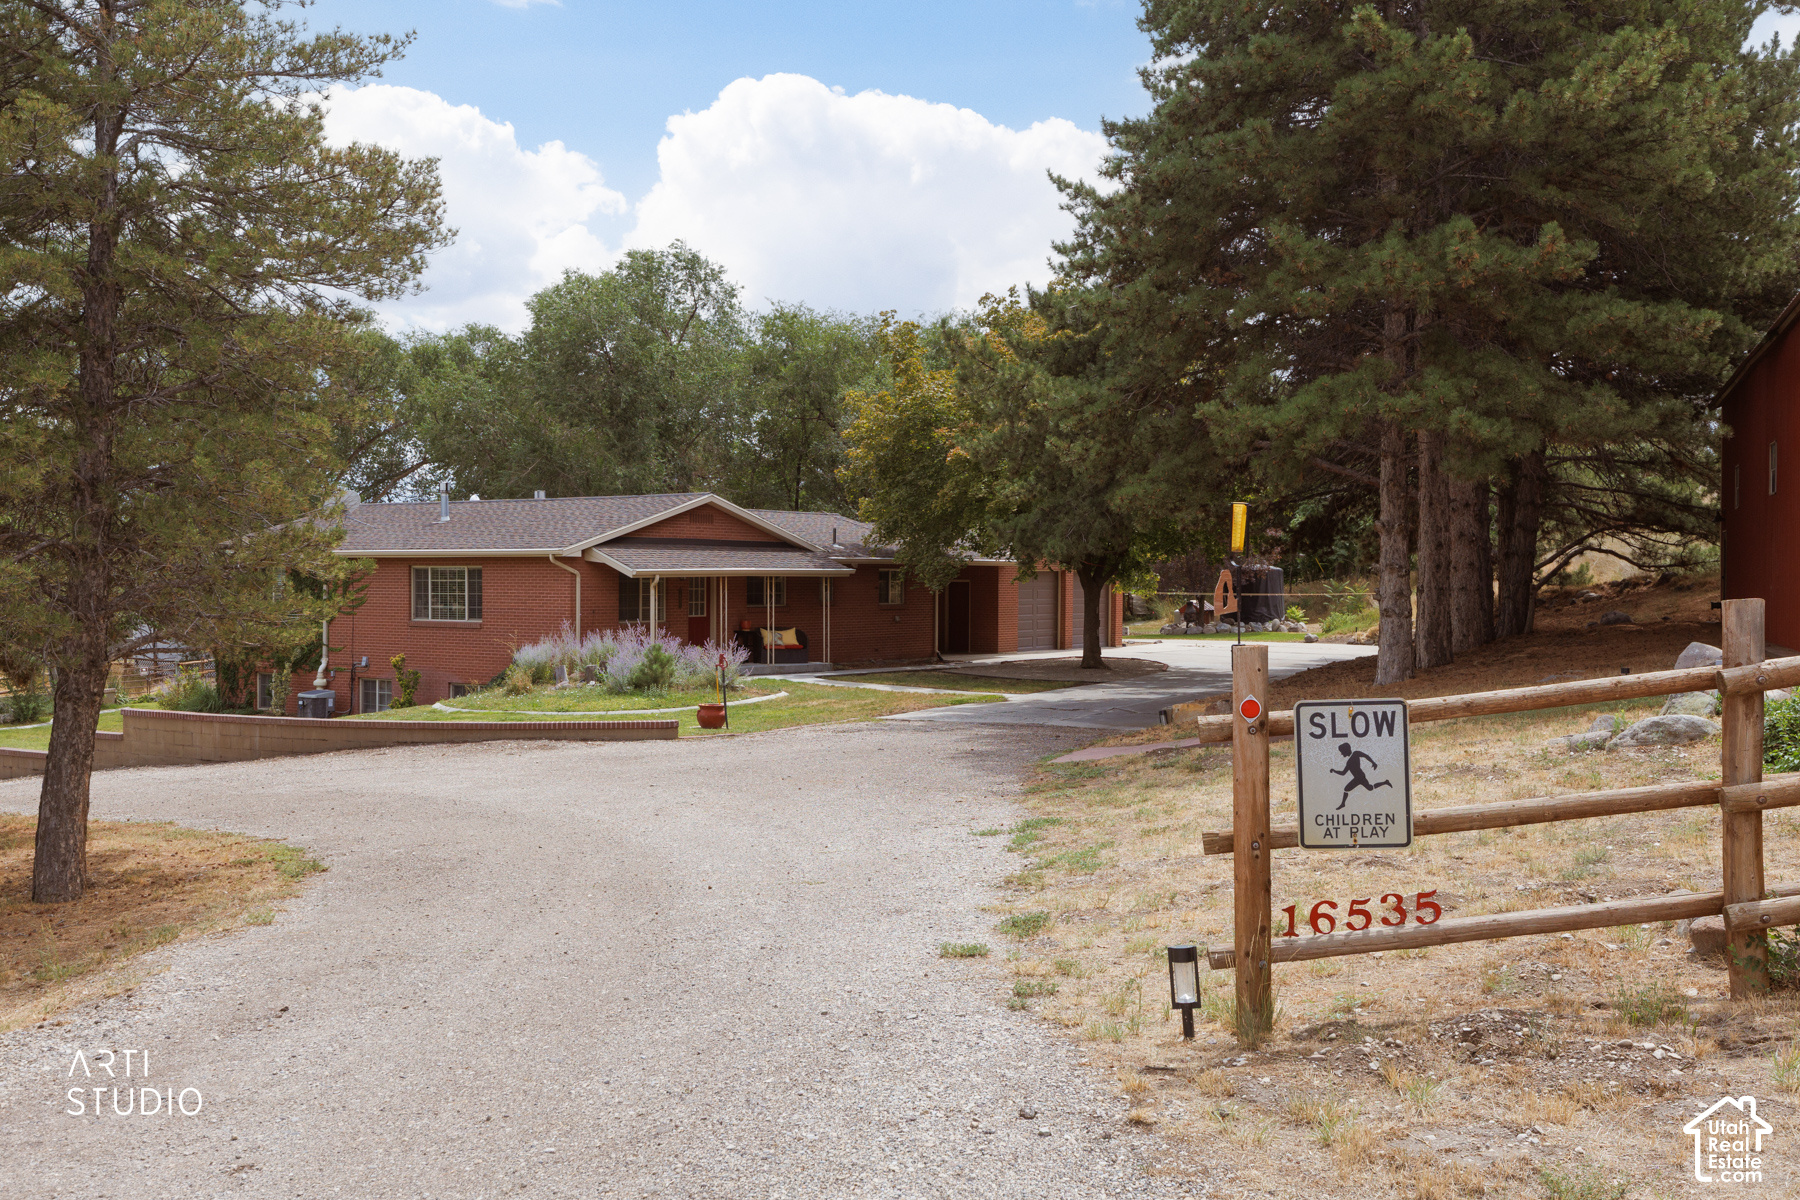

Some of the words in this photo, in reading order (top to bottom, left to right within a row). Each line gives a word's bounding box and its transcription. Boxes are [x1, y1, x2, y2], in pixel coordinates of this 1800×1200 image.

[1309, 711, 1396, 739] SLOW
[1315, 813, 1395, 826] CHILDREN
[1323, 827, 1341, 839] AT
[1350, 826, 1389, 839] PLAY
[1282, 889, 1442, 937] 16535
